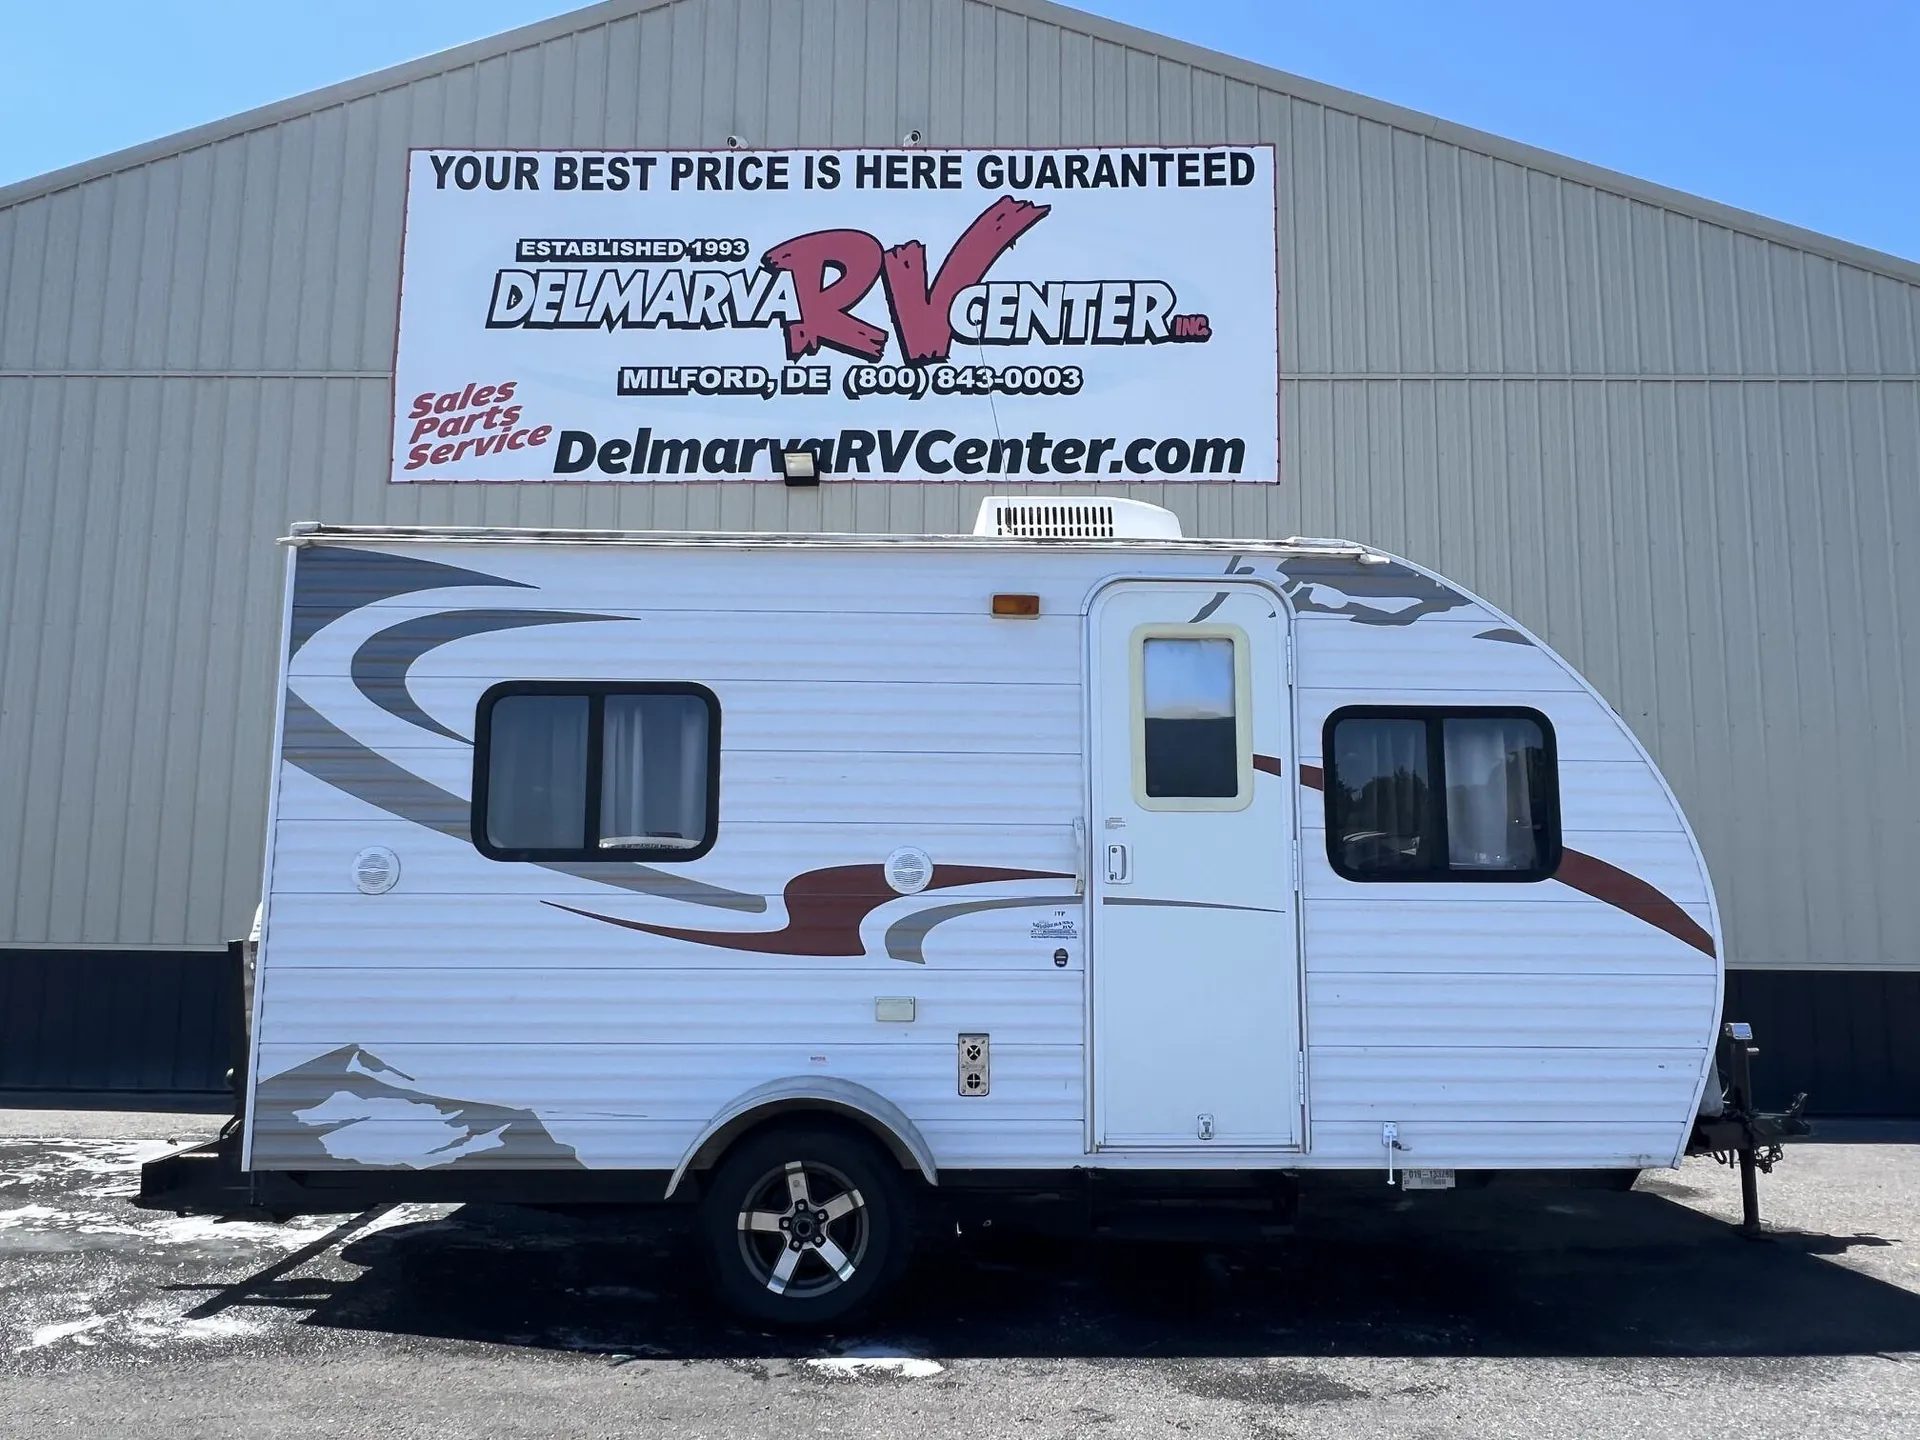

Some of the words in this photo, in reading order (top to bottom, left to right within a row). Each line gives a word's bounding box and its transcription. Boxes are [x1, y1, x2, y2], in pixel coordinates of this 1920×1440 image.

[430, 155, 540, 190] YOUR
[553, 156, 658, 191] BEST
[670, 156, 790, 191] PRICE
[803, 155, 841, 190] IS
[855, 154, 963, 189] HERE
[976, 152, 1256, 189] GUARANTEED
[517, 239, 688, 262] ESTABLISHED
[689, 239, 749, 261] 1993
[486, 268, 804, 333] DELMARVA
[762, 195, 1051, 366] RV
[948, 280, 1176, 345] CENTER
[1171, 314, 1212, 342] INC.
[408, 381, 517, 419] Sales
[618, 366, 778, 399] MILFORD,
[781, 366, 831, 395] DE
[843, 365, 928, 400] (800)
[931, 365, 1084, 396] 843-0003
[409, 405, 523, 445] Parts
[403, 425, 553, 470] Service
